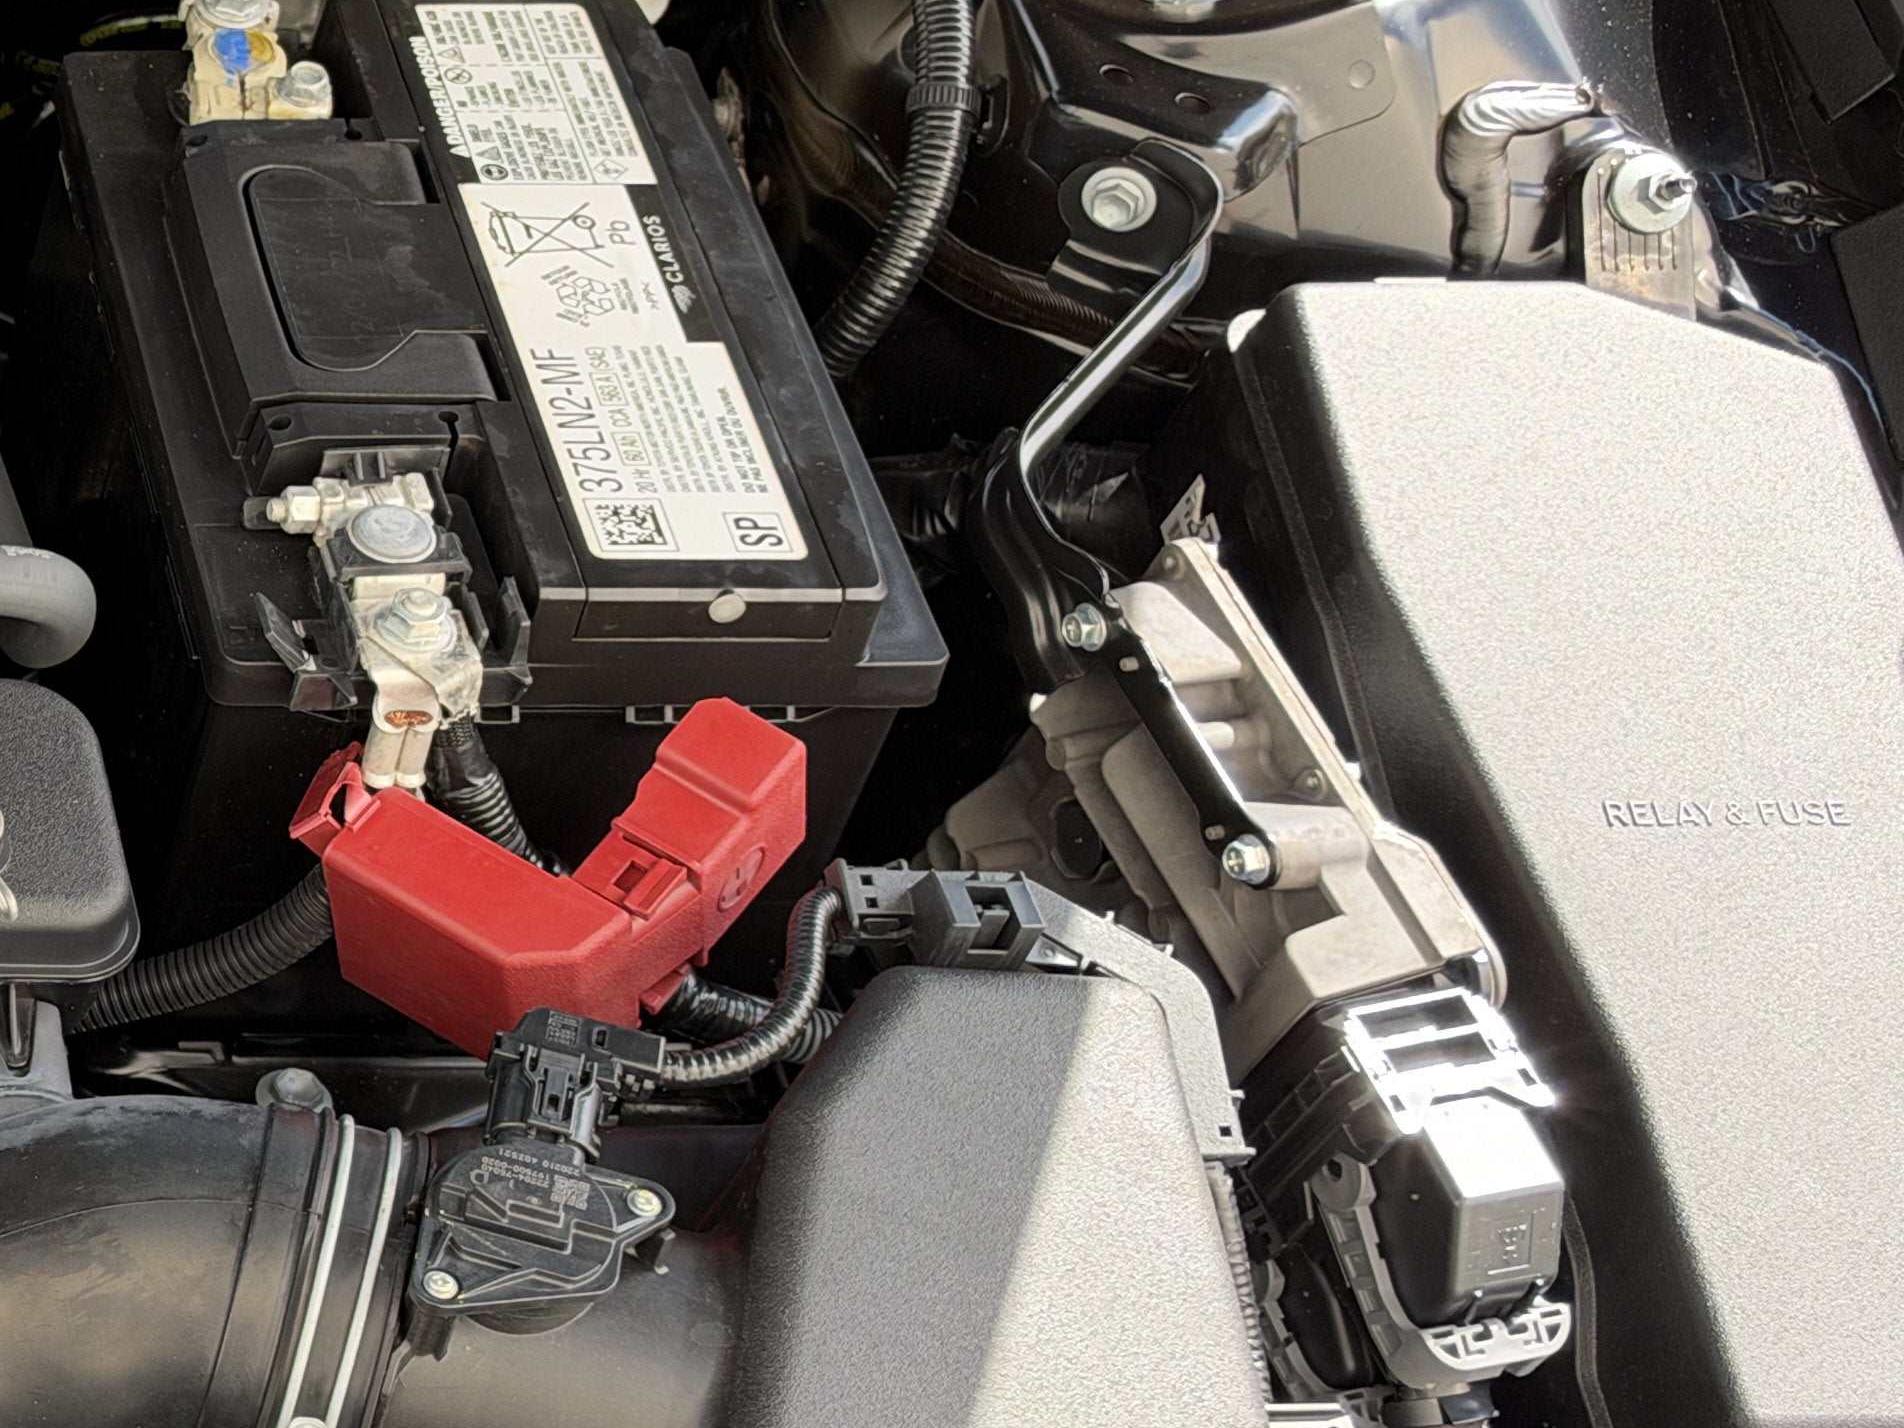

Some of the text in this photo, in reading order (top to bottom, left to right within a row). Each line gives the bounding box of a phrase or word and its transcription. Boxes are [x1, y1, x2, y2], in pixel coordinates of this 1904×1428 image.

[407, 36, 466, 144] DANGER/POISON
[602, 220, 636, 244] Pb
[640, 215, 685, 282] CLARIOS
[597, 385, 622, 400] 563
[529, 348, 624, 492] 375LN2-MF
[605, 408, 632, 426] CCA
[620, 448, 644, 460] 60
[634, 481, 657, 492] 20
[731, 517, 784, 545] SP
[1601, 800, 1851, 827] RELAY & FUSE
